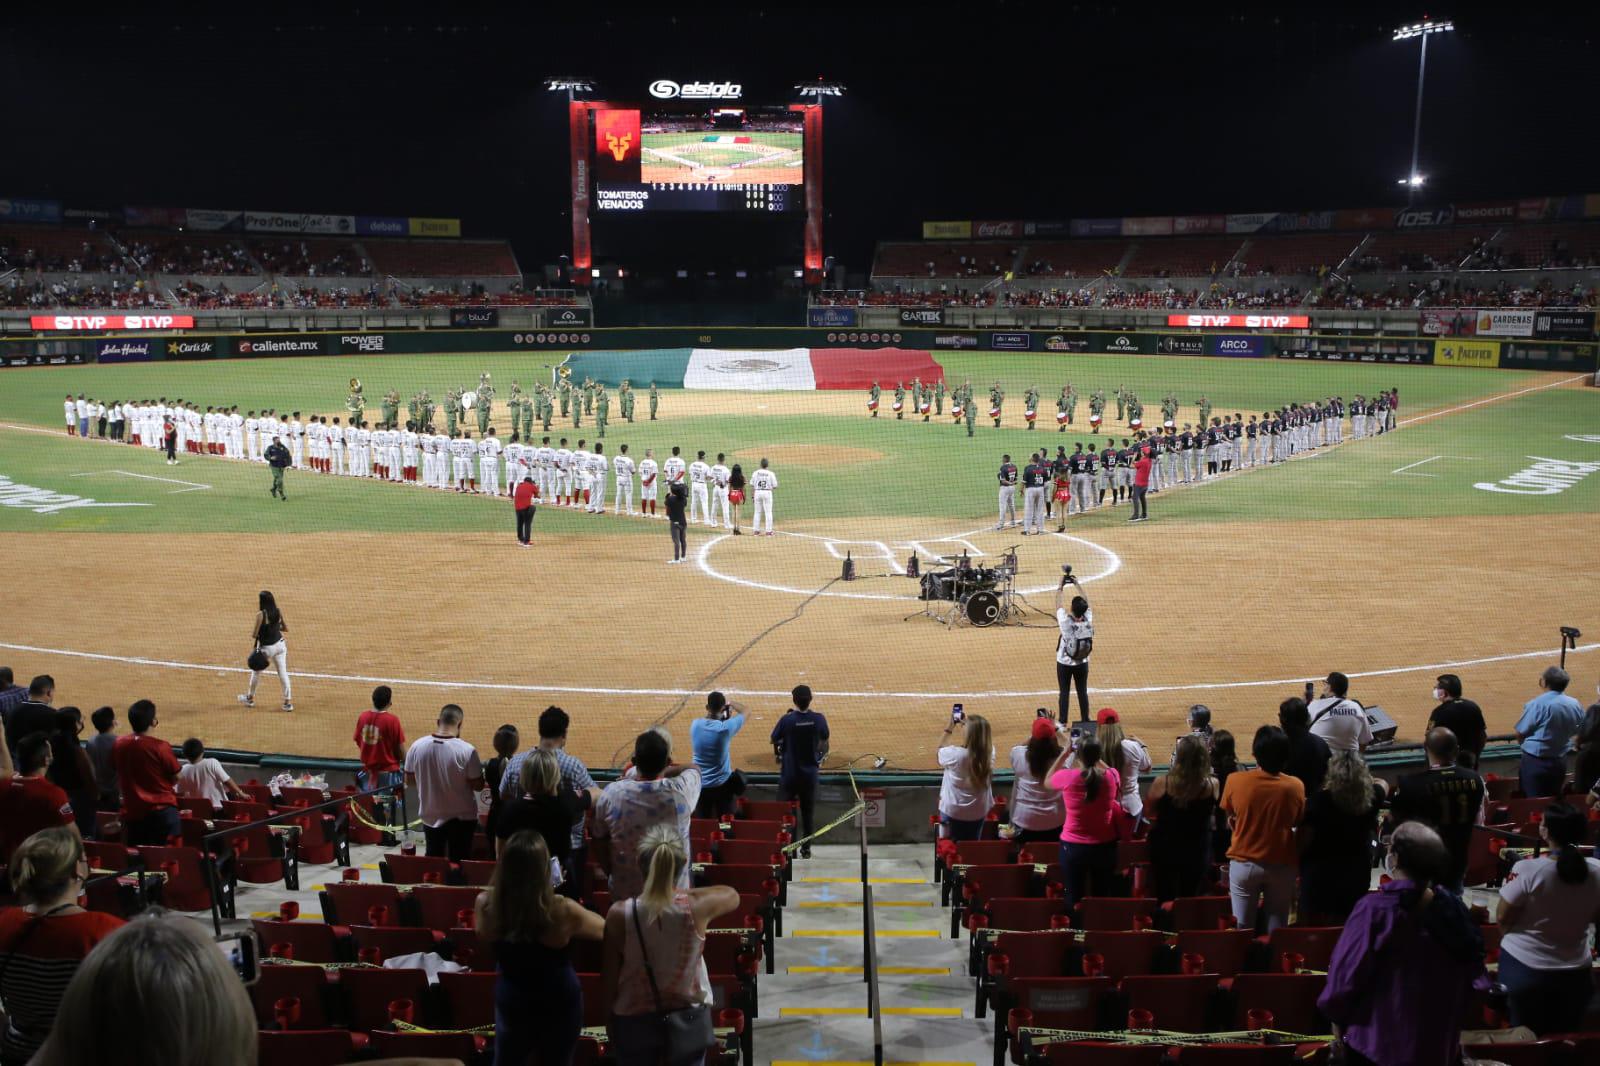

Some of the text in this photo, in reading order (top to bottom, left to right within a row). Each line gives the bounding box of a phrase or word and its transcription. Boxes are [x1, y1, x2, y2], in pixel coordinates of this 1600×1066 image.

[598, 191, 649, 200] TOMATEROS
[598, 199, 644, 209] VENADOS
[901, 311, 941, 321] CARTEK
[1492, 315, 1533, 324] CARDENAS
[72, 316, 174, 329] TVP TVP
[1203, 316, 1290, 327] TVP TVP
[341, 335, 384, 345] POWER
[1220, 340, 1248, 349] ARCO
[252, 340, 318, 352] caliente.mx
